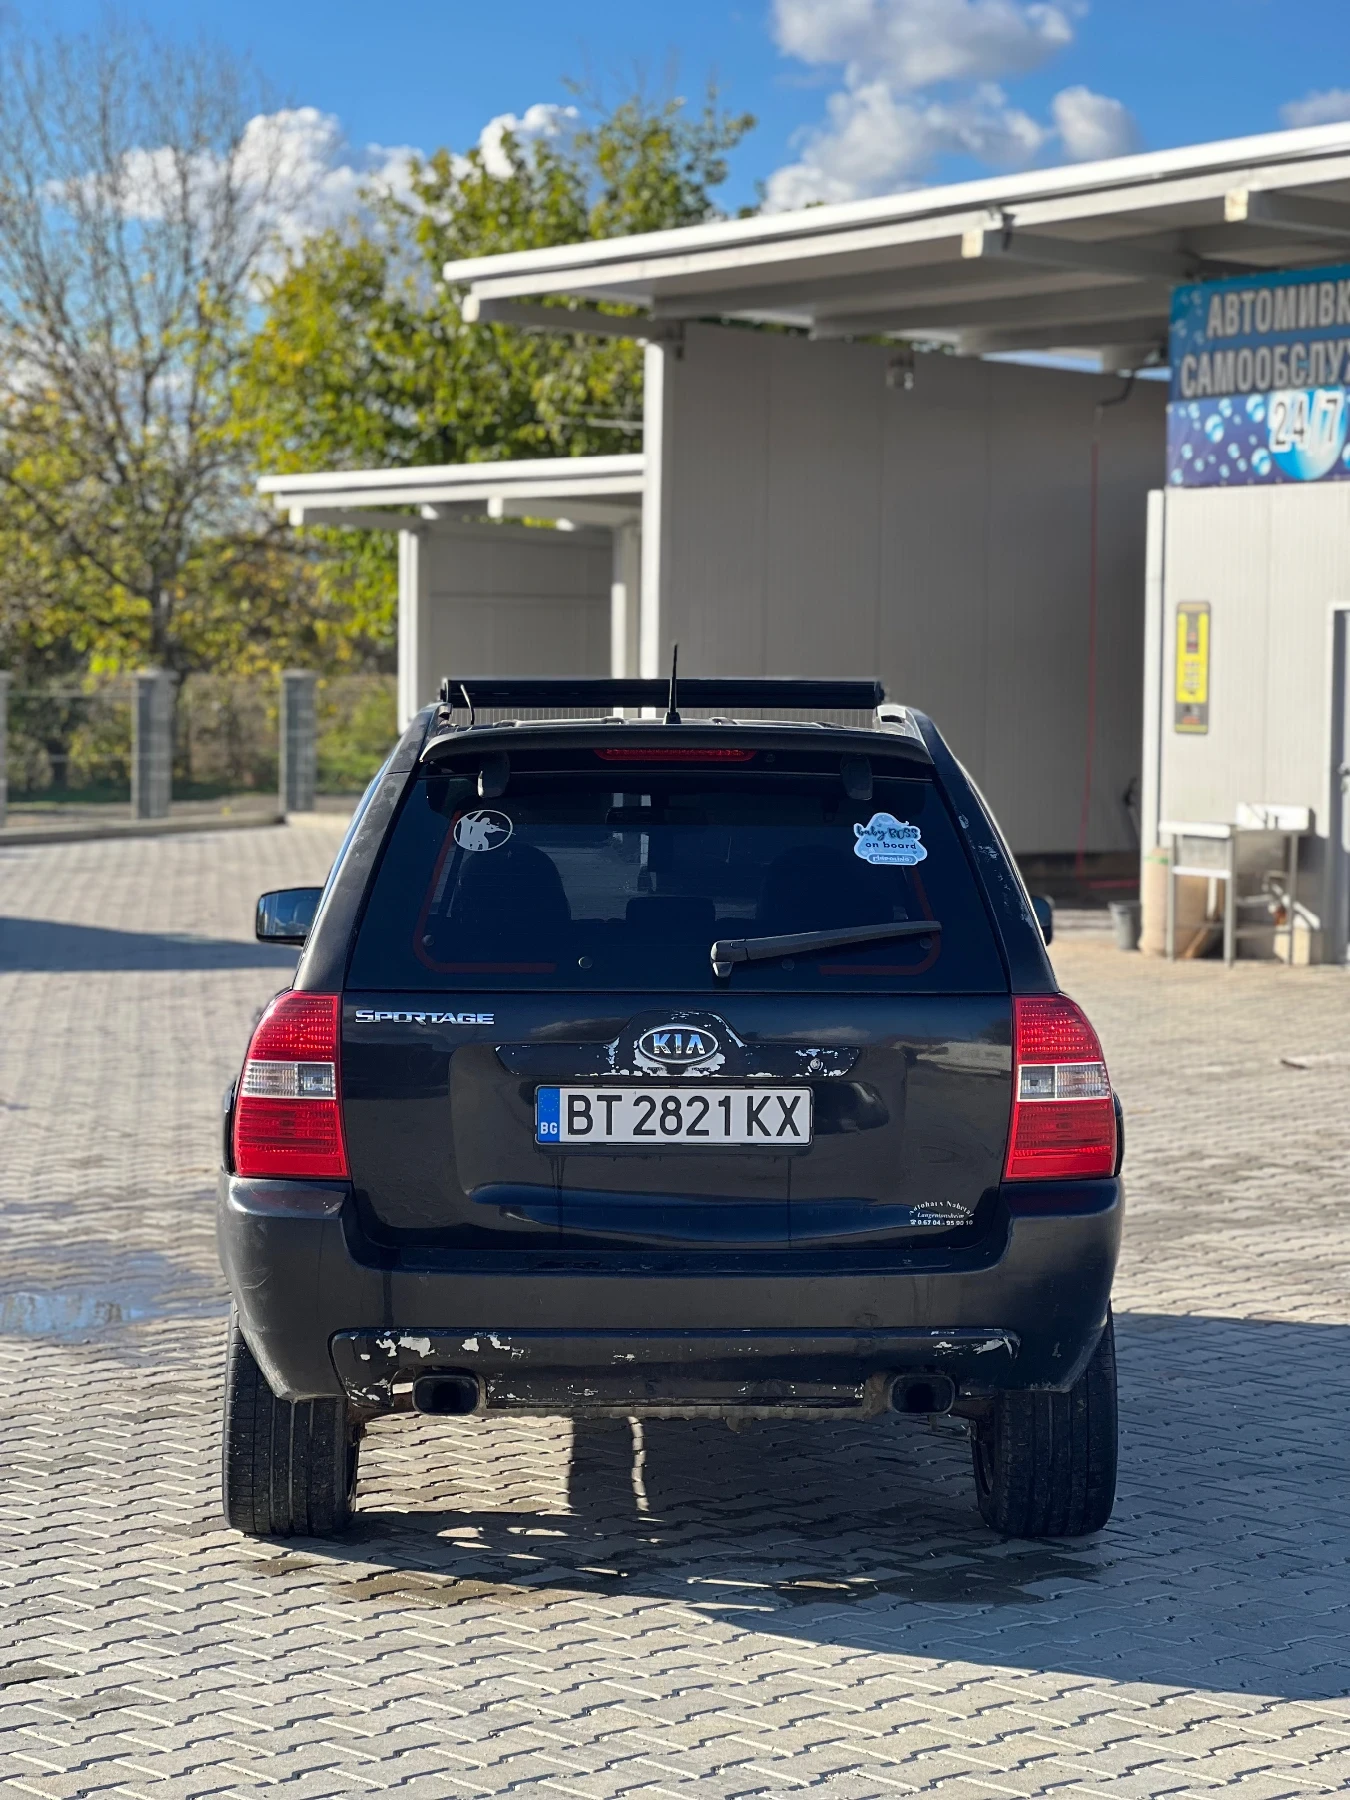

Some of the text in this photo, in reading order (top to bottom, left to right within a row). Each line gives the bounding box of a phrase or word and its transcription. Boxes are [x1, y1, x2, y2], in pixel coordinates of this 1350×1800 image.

[1271, 393, 1343, 451] 24/7
[856, 825, 919, 841] baby BOSS
[355, 1009, 495, 1026] SPORTAGE
[652, 1034, 705, 1056] KIA
[567, 1094, 802, 1137] BT 2821 KX
[540, 1122, 558, 1135] BG
